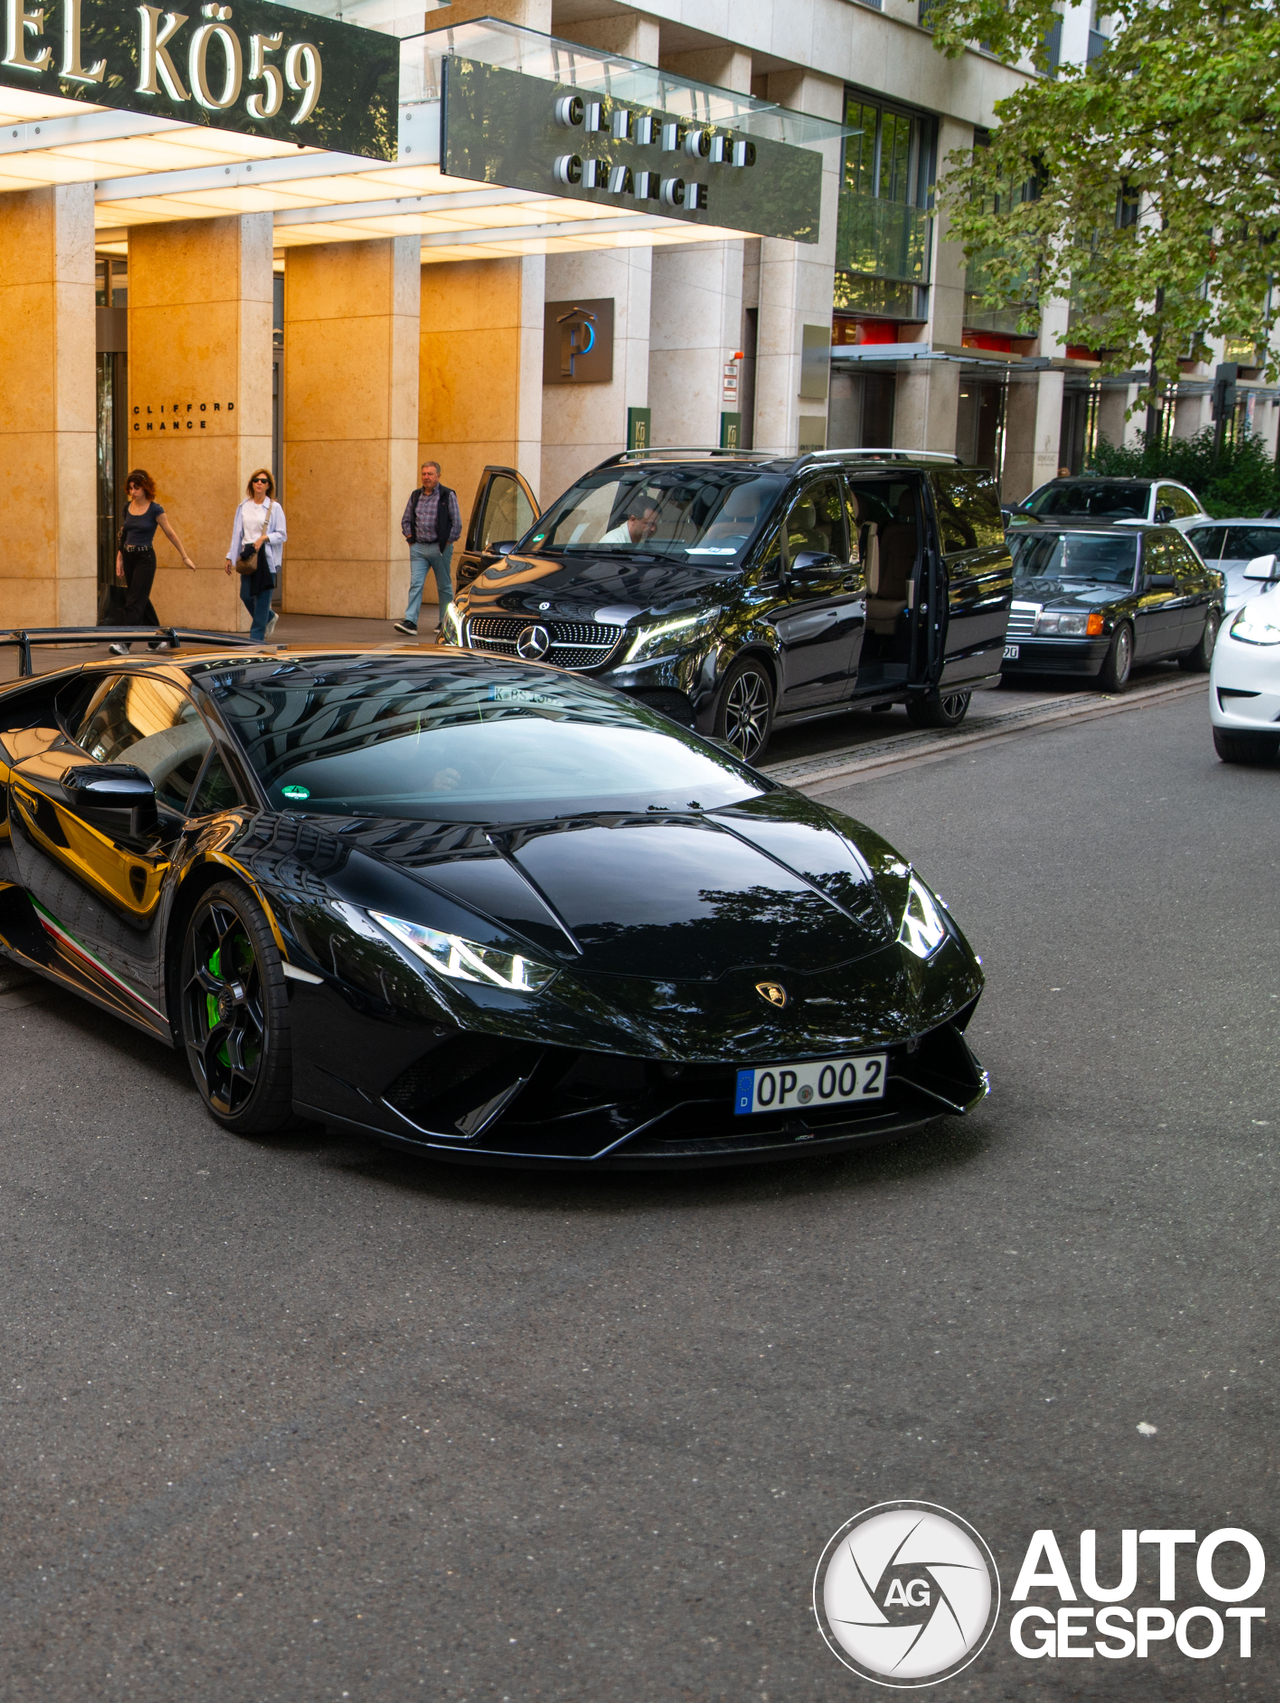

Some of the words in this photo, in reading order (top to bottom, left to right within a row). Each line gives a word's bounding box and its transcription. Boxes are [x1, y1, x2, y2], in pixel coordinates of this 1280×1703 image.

[136, 2, 322, 125] KÖ59
[556, 96, 757, 167] CLIFFORD
[554, 155, 708, 210] CHANCE
[133, 402, 234, 414] CLIFFORD
[133, 420, 206, 431] CHANCE
[740, 1097, 748, 1107] D
